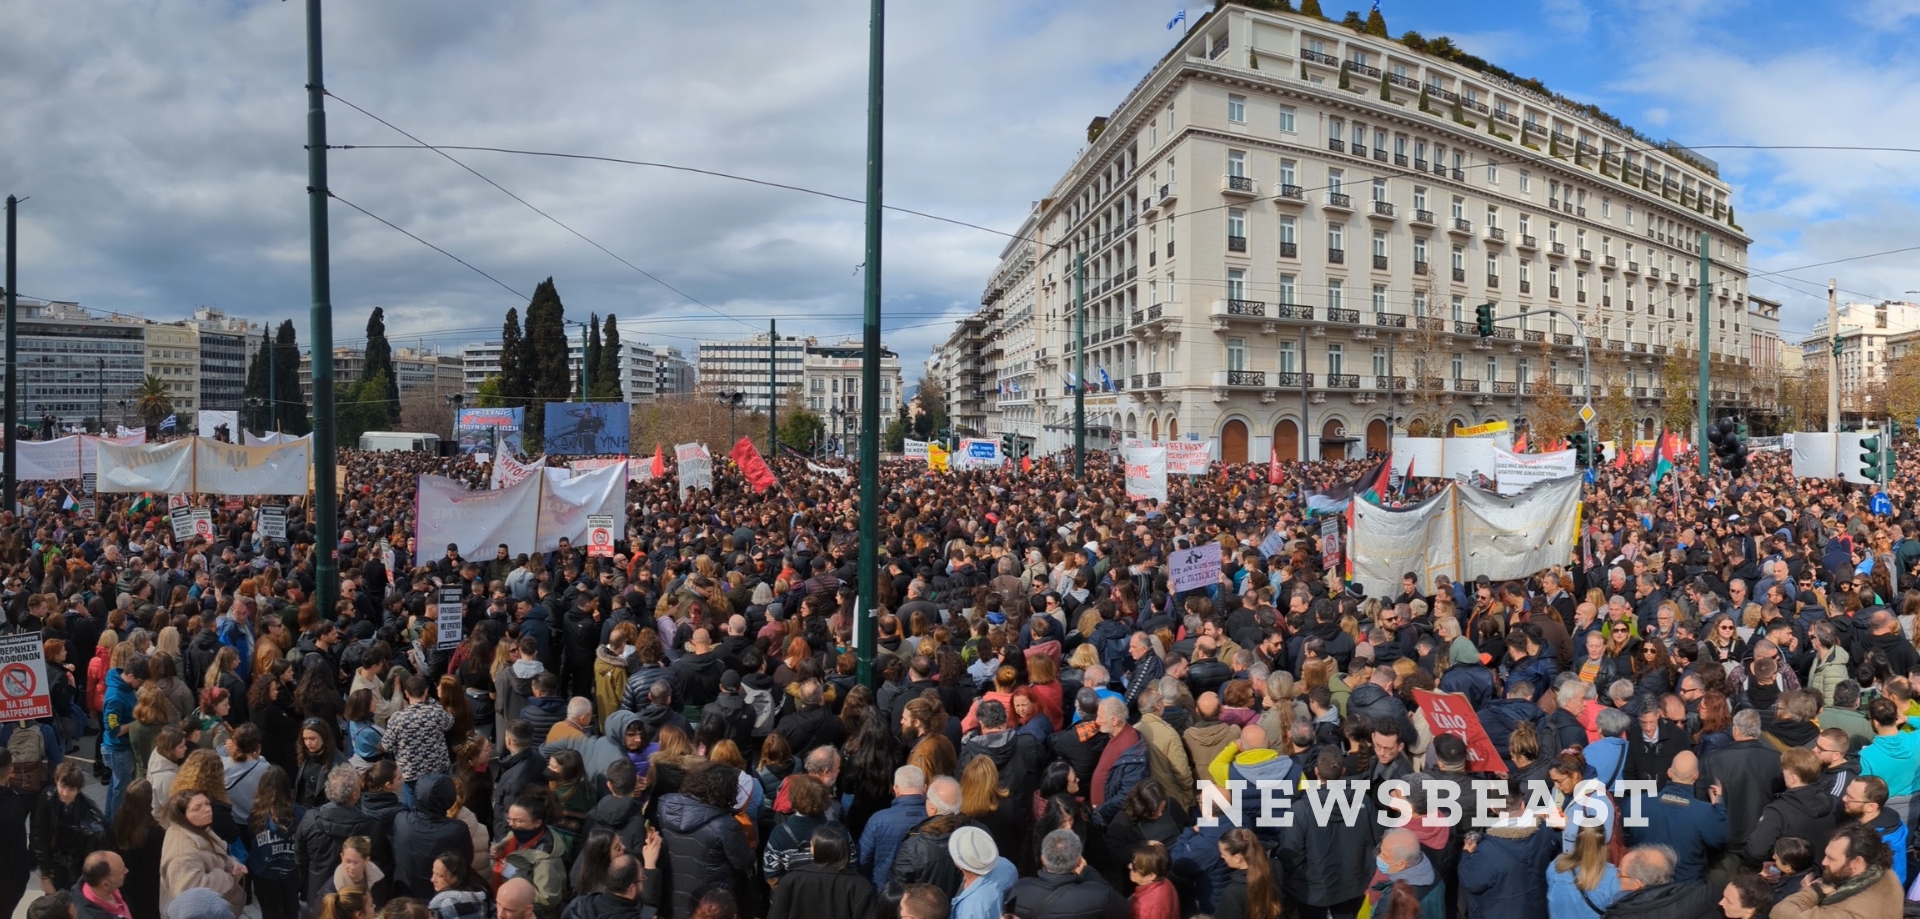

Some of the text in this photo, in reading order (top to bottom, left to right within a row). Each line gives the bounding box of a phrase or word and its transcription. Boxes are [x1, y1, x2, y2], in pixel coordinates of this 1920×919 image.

[6, 698, 34, 709] ΝΑ ΤΗΝ
[1431, 697, 1452, 713] ΔΙ
[1430, 711, 1467, 730] ΚΑΙΟ
[271, 843, 295, 855] HILLS
